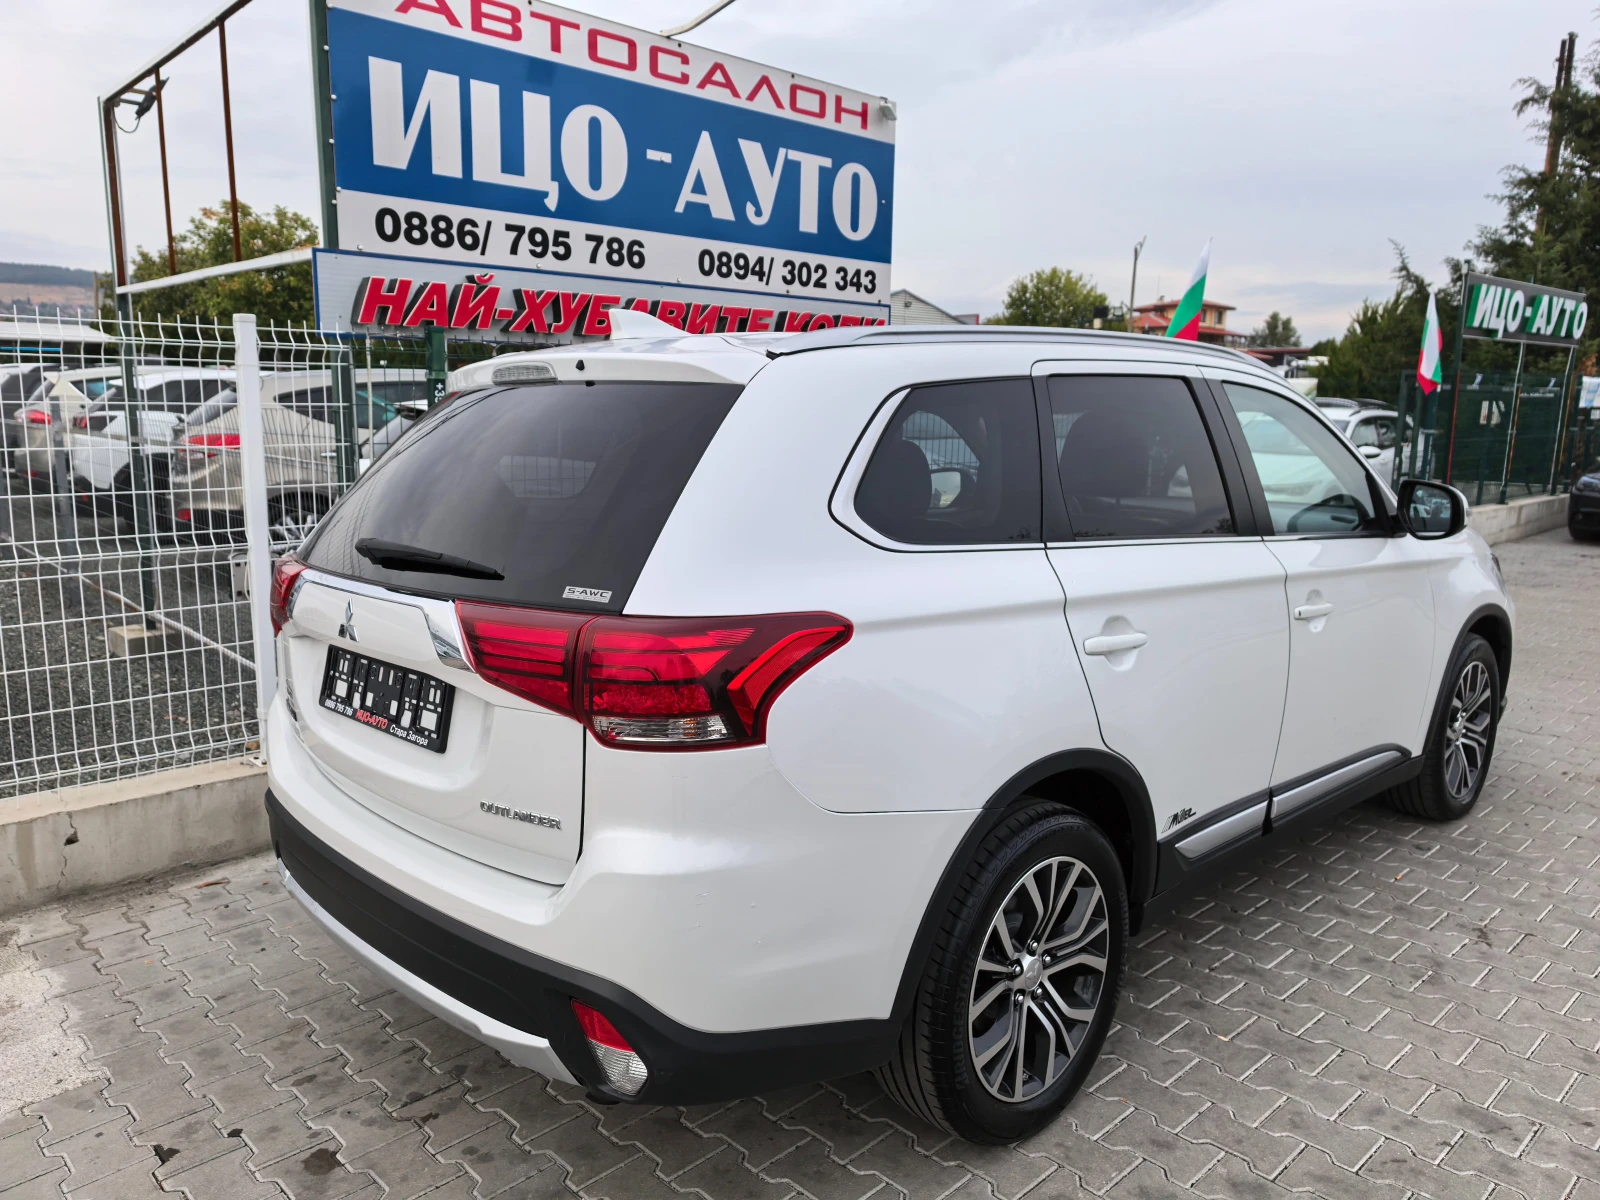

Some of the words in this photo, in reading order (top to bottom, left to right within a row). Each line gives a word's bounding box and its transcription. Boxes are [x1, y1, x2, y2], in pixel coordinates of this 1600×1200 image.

[375, 207, 492, 256] 0886/
[505, 223, 572, 261] 795
[585, 233, 646, 269] 786
[698, 249, 774, 286] 0894/
[782, 259, 828, 289] 302
[835, 266, 877, 294] 343
[1473, 283, 1589, 340] ИЦО-АУТО
[566, 587, 610, 598] S-AWC
[355, 708, 389, 730] ИЦО-АУТО
[389, 724, 408, 739] Стара
[406, 731, 429, 747] Загора
[480, 800, 562, 831] OUTLANDER
